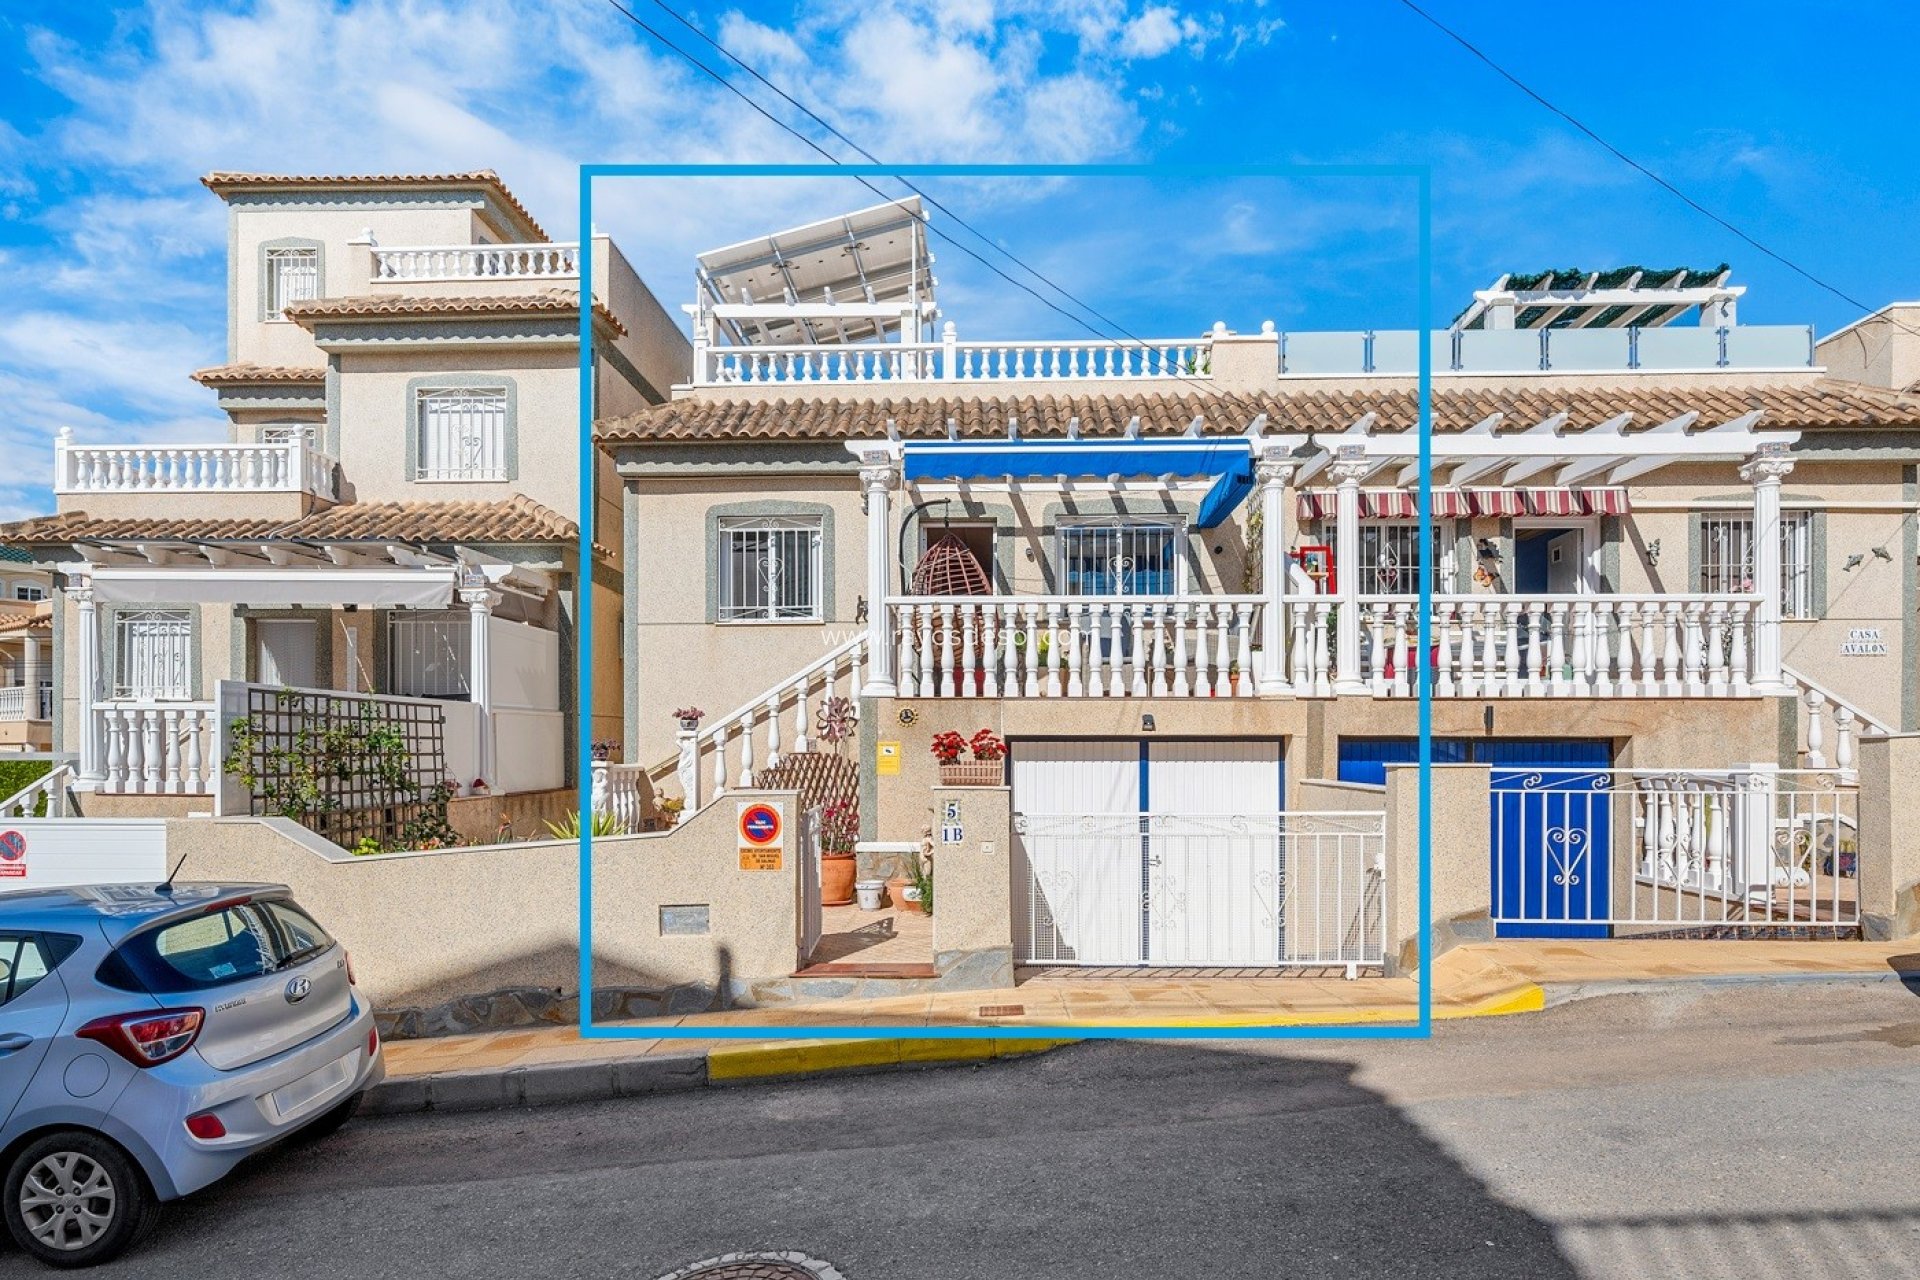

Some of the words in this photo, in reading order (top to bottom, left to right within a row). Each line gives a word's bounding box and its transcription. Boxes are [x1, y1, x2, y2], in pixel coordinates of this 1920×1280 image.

[1850, 630, 1878, 639] CASA
[1843, 644, 1885, 653] AVALON
[947, 803, 956, 819] 5
